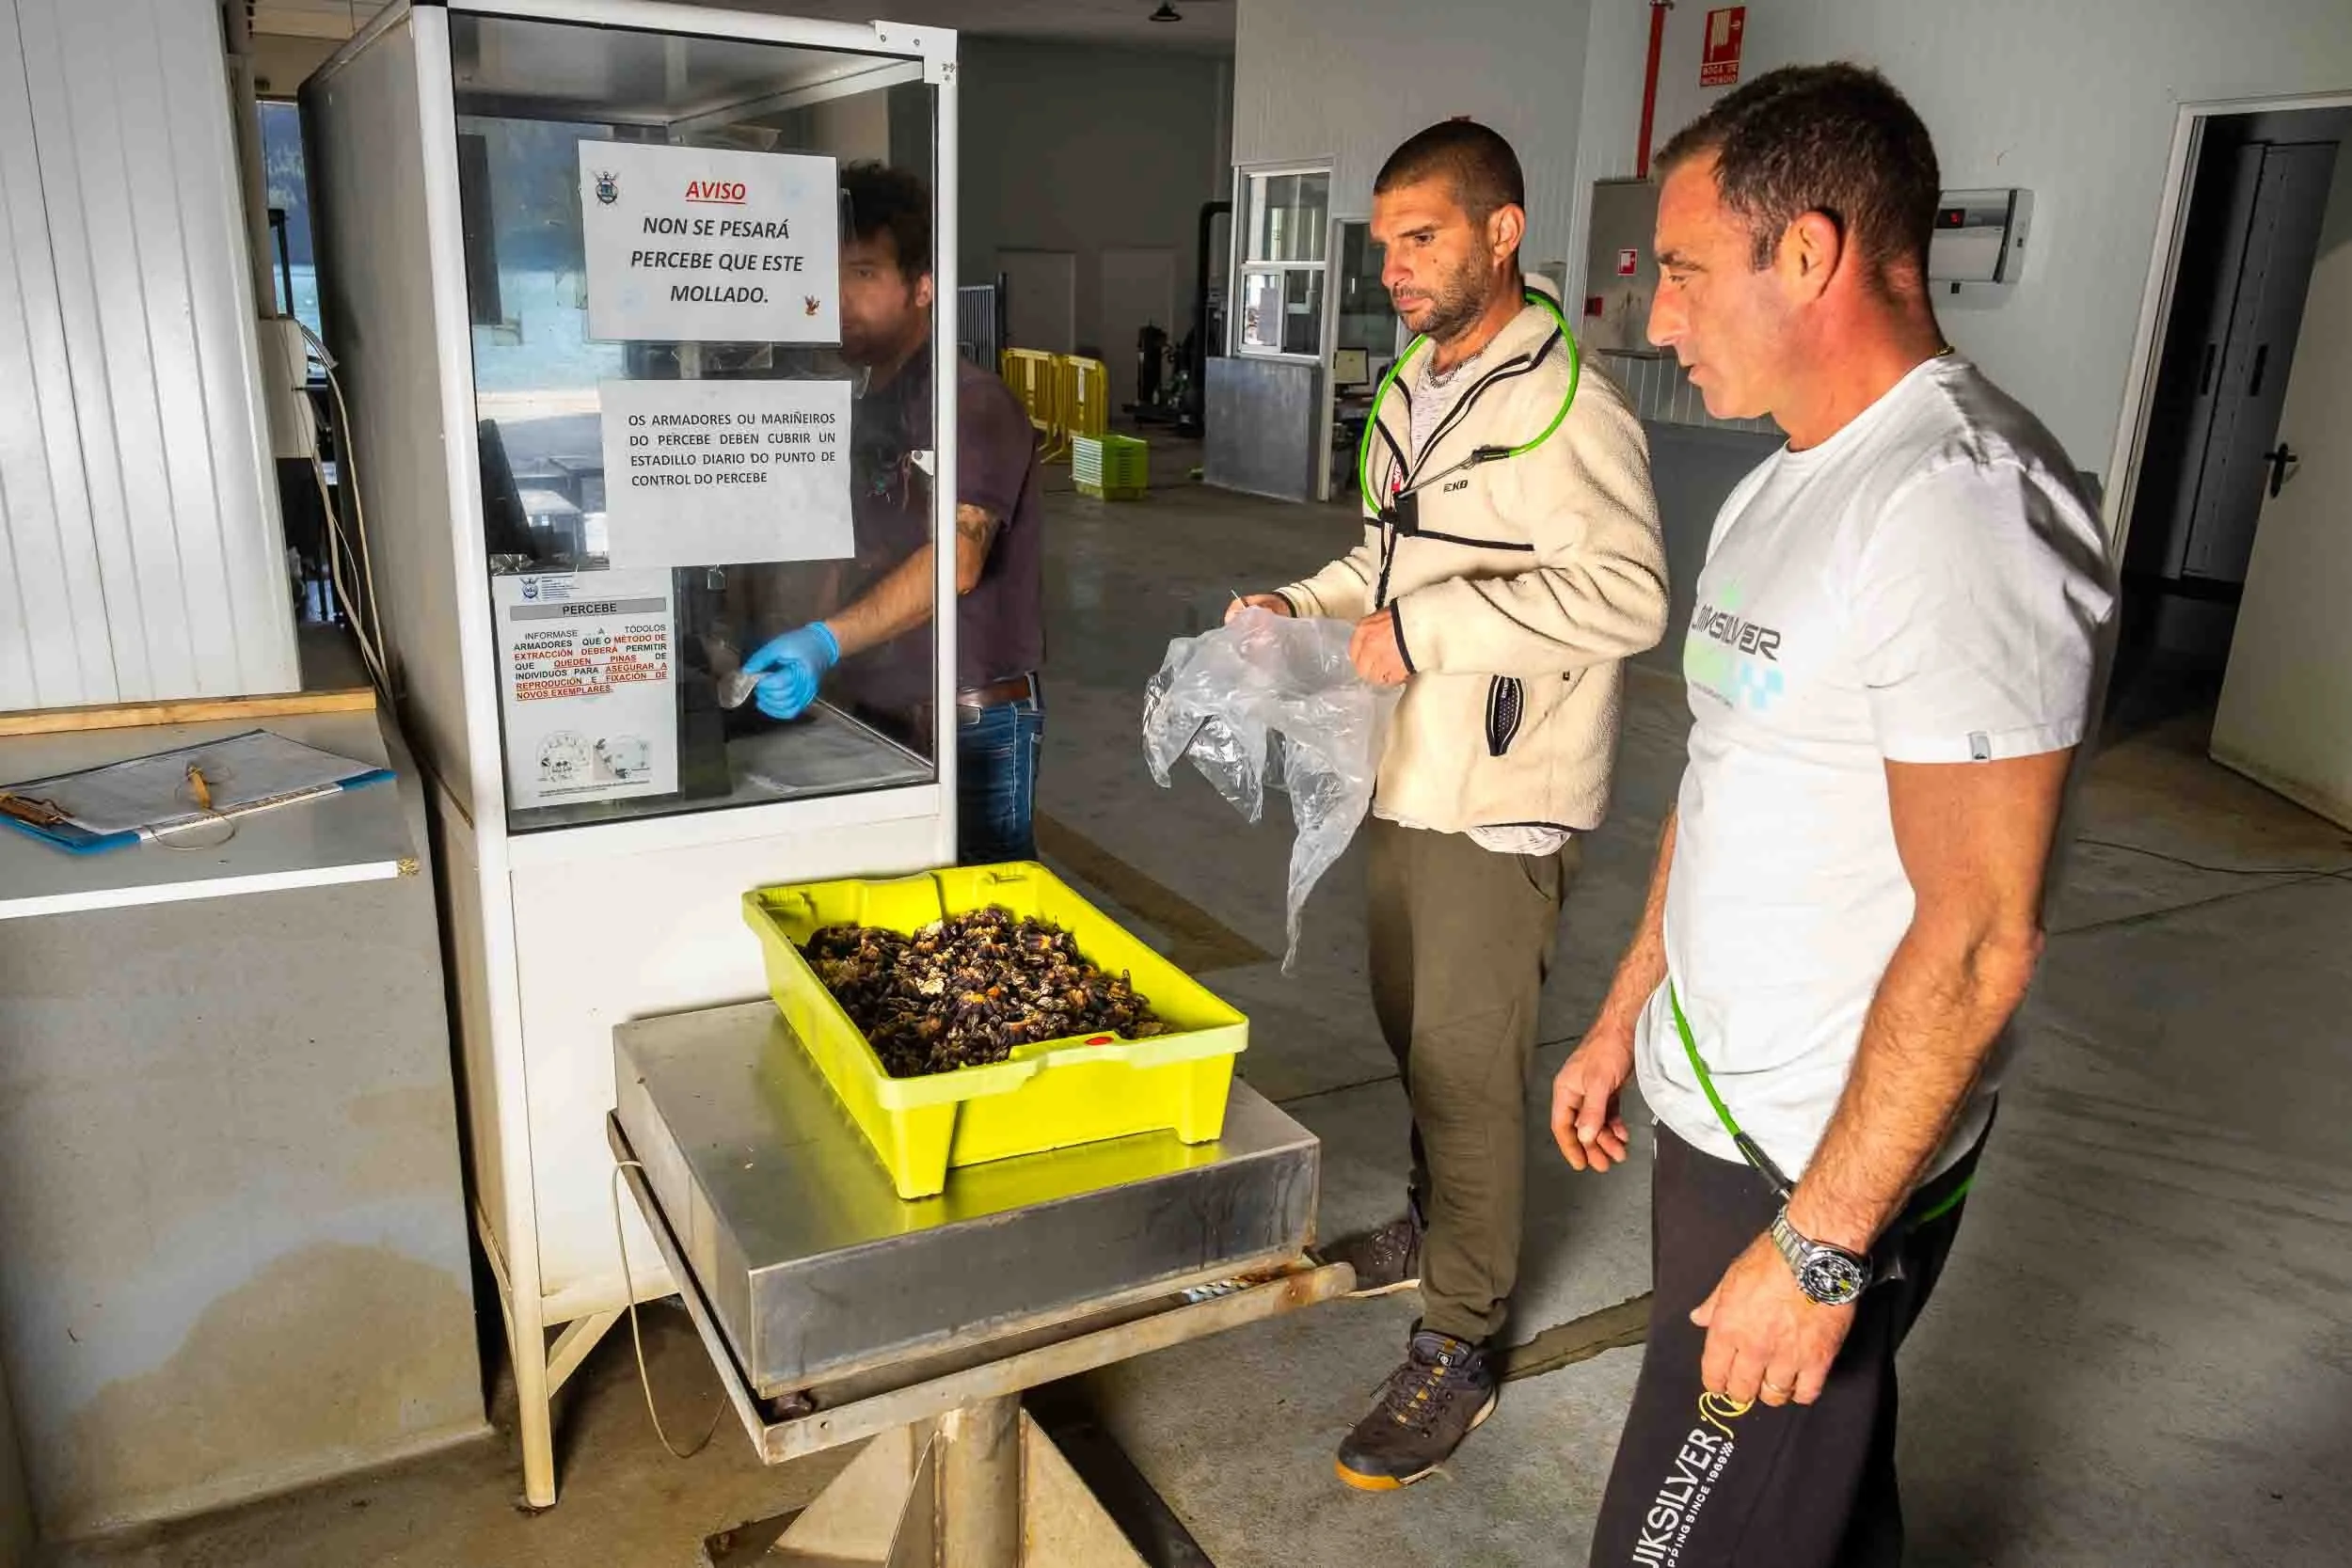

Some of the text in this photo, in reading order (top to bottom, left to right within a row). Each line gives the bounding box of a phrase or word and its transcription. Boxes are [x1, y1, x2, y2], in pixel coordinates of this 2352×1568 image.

[685, 181, 747, 201] AVISO
[643, 217, 789, 239] NON SE PESARÁ
[631, 250, 804, 273] PERCEBE QUE ESTE
[670, 285, 769, 303] MOLLADO.
[628, 410, 835, 426] OS ARMADORES OU MARIÑEIROS
[629, 433, 836, 446] DO PERCEBE DEBEN CUBRIR UN
[630, 451, 835, 467] ESTADILLO DIARIO DO PUNTO DE
[631, 472, 768, 486] CONTROL DO PERCEBE
[562, 603, 617, 615] PERCEBE
[514, 640, 573, 651] ARMADORES
[581, 637, 602, 646] QUE
[604, 636, 612, 644] O
[626, 643, 667, 653] PERMITIR
[515, 662, 535, 671] QUE
[554, 657, 592, 668] QUEDEN
[656, 652, 667, 660] DE
[516, 669, 567, 681] INDIVIDUOS
[574, 667, 599, 676] PARA
[606, 662, 655, 673] ASEGURAR
[656, 671, 667, 679] DE
[516, 689, 548, 701] NOVOS
[1685, 1485, 1711, 1523] SINCE
[1706, 1455, 1728, 1482] 1969
